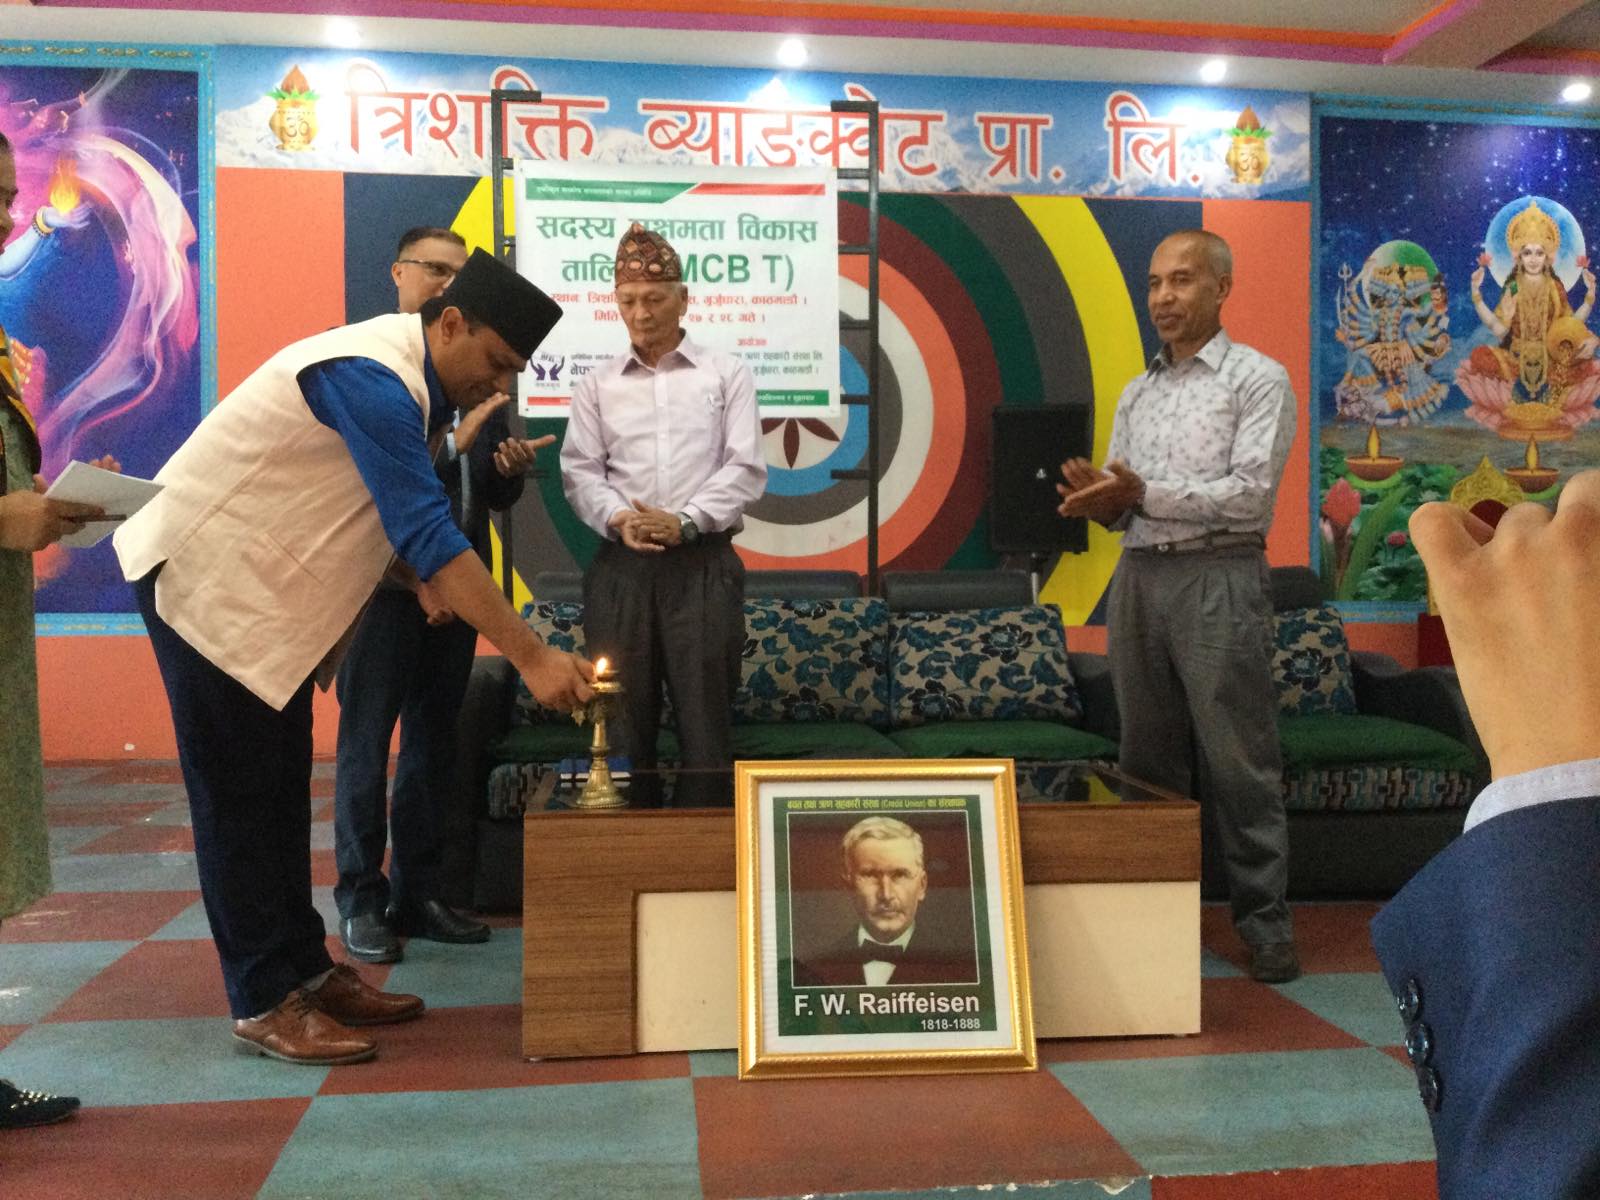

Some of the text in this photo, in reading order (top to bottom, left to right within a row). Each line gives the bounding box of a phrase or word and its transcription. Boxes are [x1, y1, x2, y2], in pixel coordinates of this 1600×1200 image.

[345, 63, 605, 161] त्रिशक्ति
[978, 115, 1062, 178] प्रा.
[1108, 94, 1200, 182] लि.
[536, 216, 616, 239] सदस्य
[738, 213, 818, 243] विकास
[794, 992, 980, 1016] F. W. Raiffeisen
[920, 1018, 981, 1031] 1818-1888
